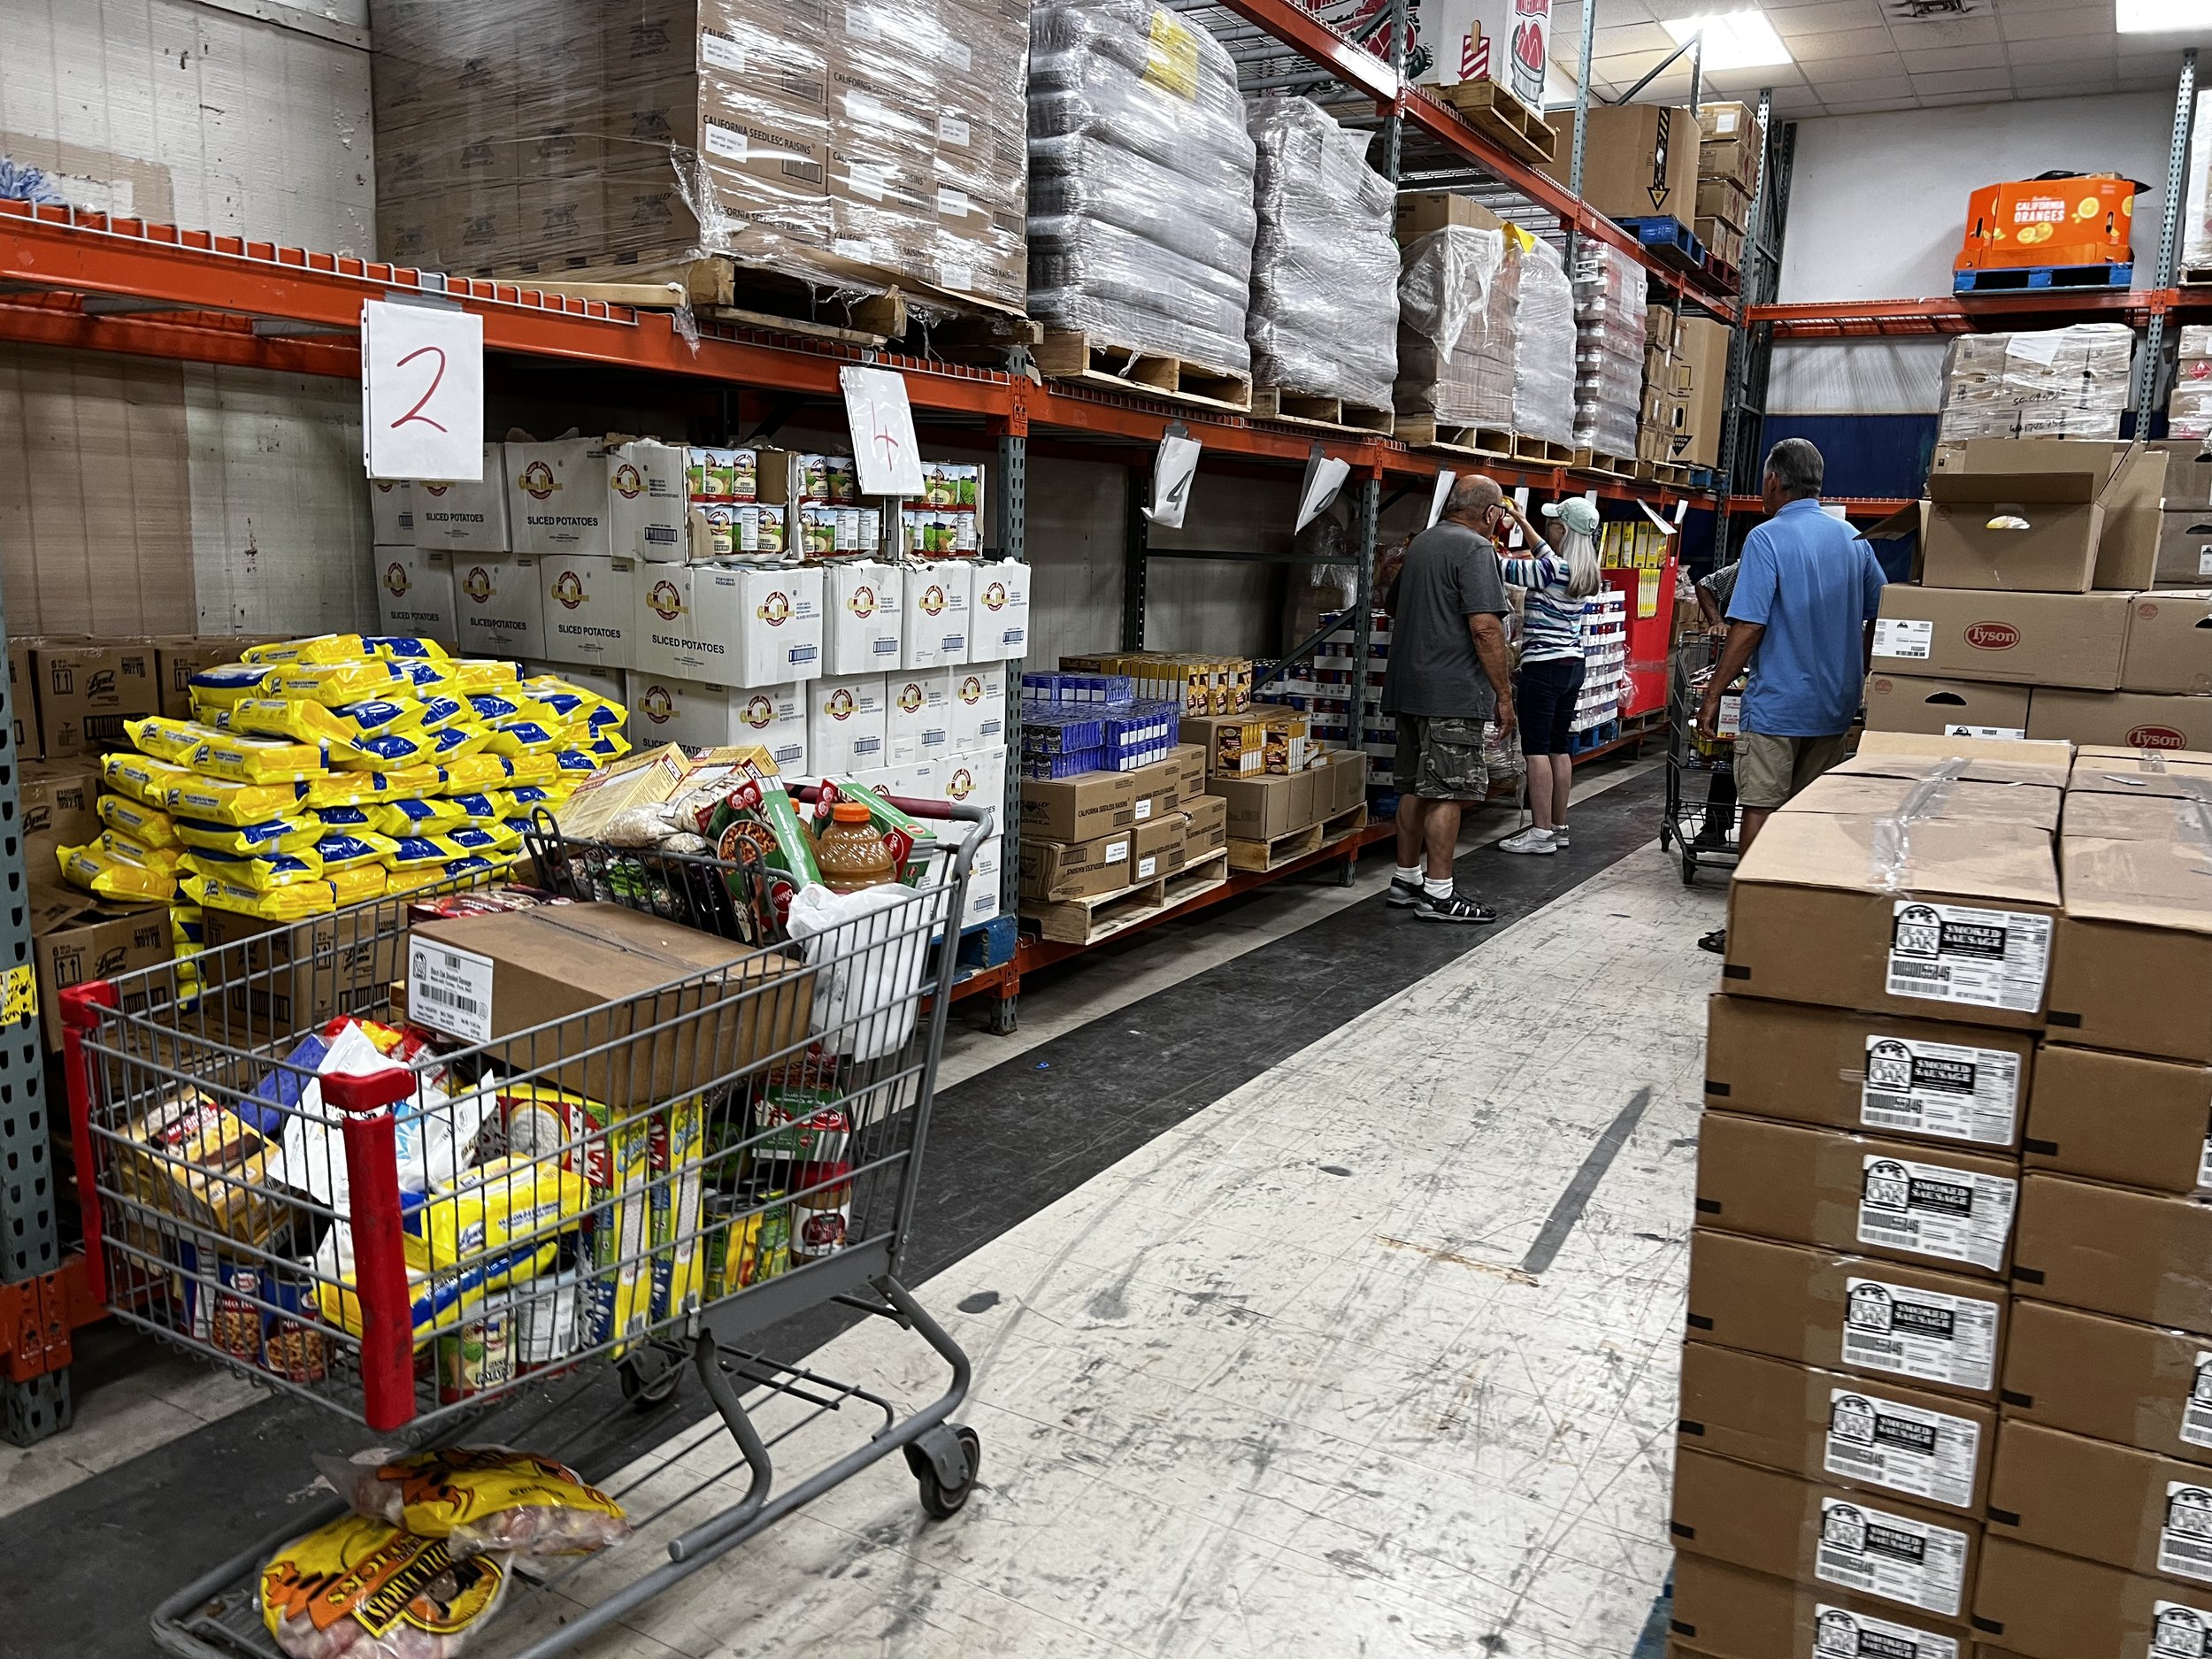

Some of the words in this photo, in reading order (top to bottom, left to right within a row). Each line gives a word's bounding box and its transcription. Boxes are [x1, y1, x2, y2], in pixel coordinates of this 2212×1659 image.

[703, 115, 748, 137] CALIFORNIA
[749, 128, 784, 146] SEEDLESS
[784, 137, 811, 155] RAISINS
[2016, 201, 2065, 211] CALIFORNIA
[2014, 210, 2065, 223] ORANGES
[391, 346, 448, 433] 2
[426, 513, 449, 522] SLICED
[450, 513, 484, 523] POTATOES
[527, 516, 555, 526] SLICED
[556, 517, 598, 526] POTATOES
[391, 611, 410, 620] SLICED
[411, 612, 439, 621] POTATOES
[470, 618, 491, 627] SLICED
[491, 619, 526, 630] POTATOES
[558, 625, 581, 634] SLICED
[583, 627, 621, 639] POTATOES
[1970, 626, 2017, 644] Tyson
[652, 634, 680, 648] SLICED
[681, 639, 725, 654] POTATOES
[643, 738, 666, 749] SLICE
[2134, 733, 2181, 749] Tyson
[1078, 807, 1099, 818] CALIFORNIA
[1099, 803, 1115, 813] SEEDLESS
[1115, 800, 1128, 810] RAISINS
[1899, 926, 1936, 937] BLACK
[1945, 925, 2002, 939] SMOKED
[1898, 934, 1935, 949] OAK
[1943, 933, 2002, 948] SAUSAGE
[1871, 1061, 1909, 1072] BLACK
[1916, 1060, 1972, 1074] SMOKED
[1870, 1068, 1908, 1083] OAK
[1914, 1068, 1971, 1082] SAUSAGE
[1868, 1187, 1905, 1203] OAK
[1913, 1180, 1970, 1197] SMOKED
[1910, 1189, 1969, 1205] SAUSAGE
[1851, 1309, 1888, 1325] OAK
[1895, 1303, 1951, 1320] SMOKED
[1893, 1311, 1951, 1328] SAUSAGE
[365, 1570, 418, 1624] FARMS
